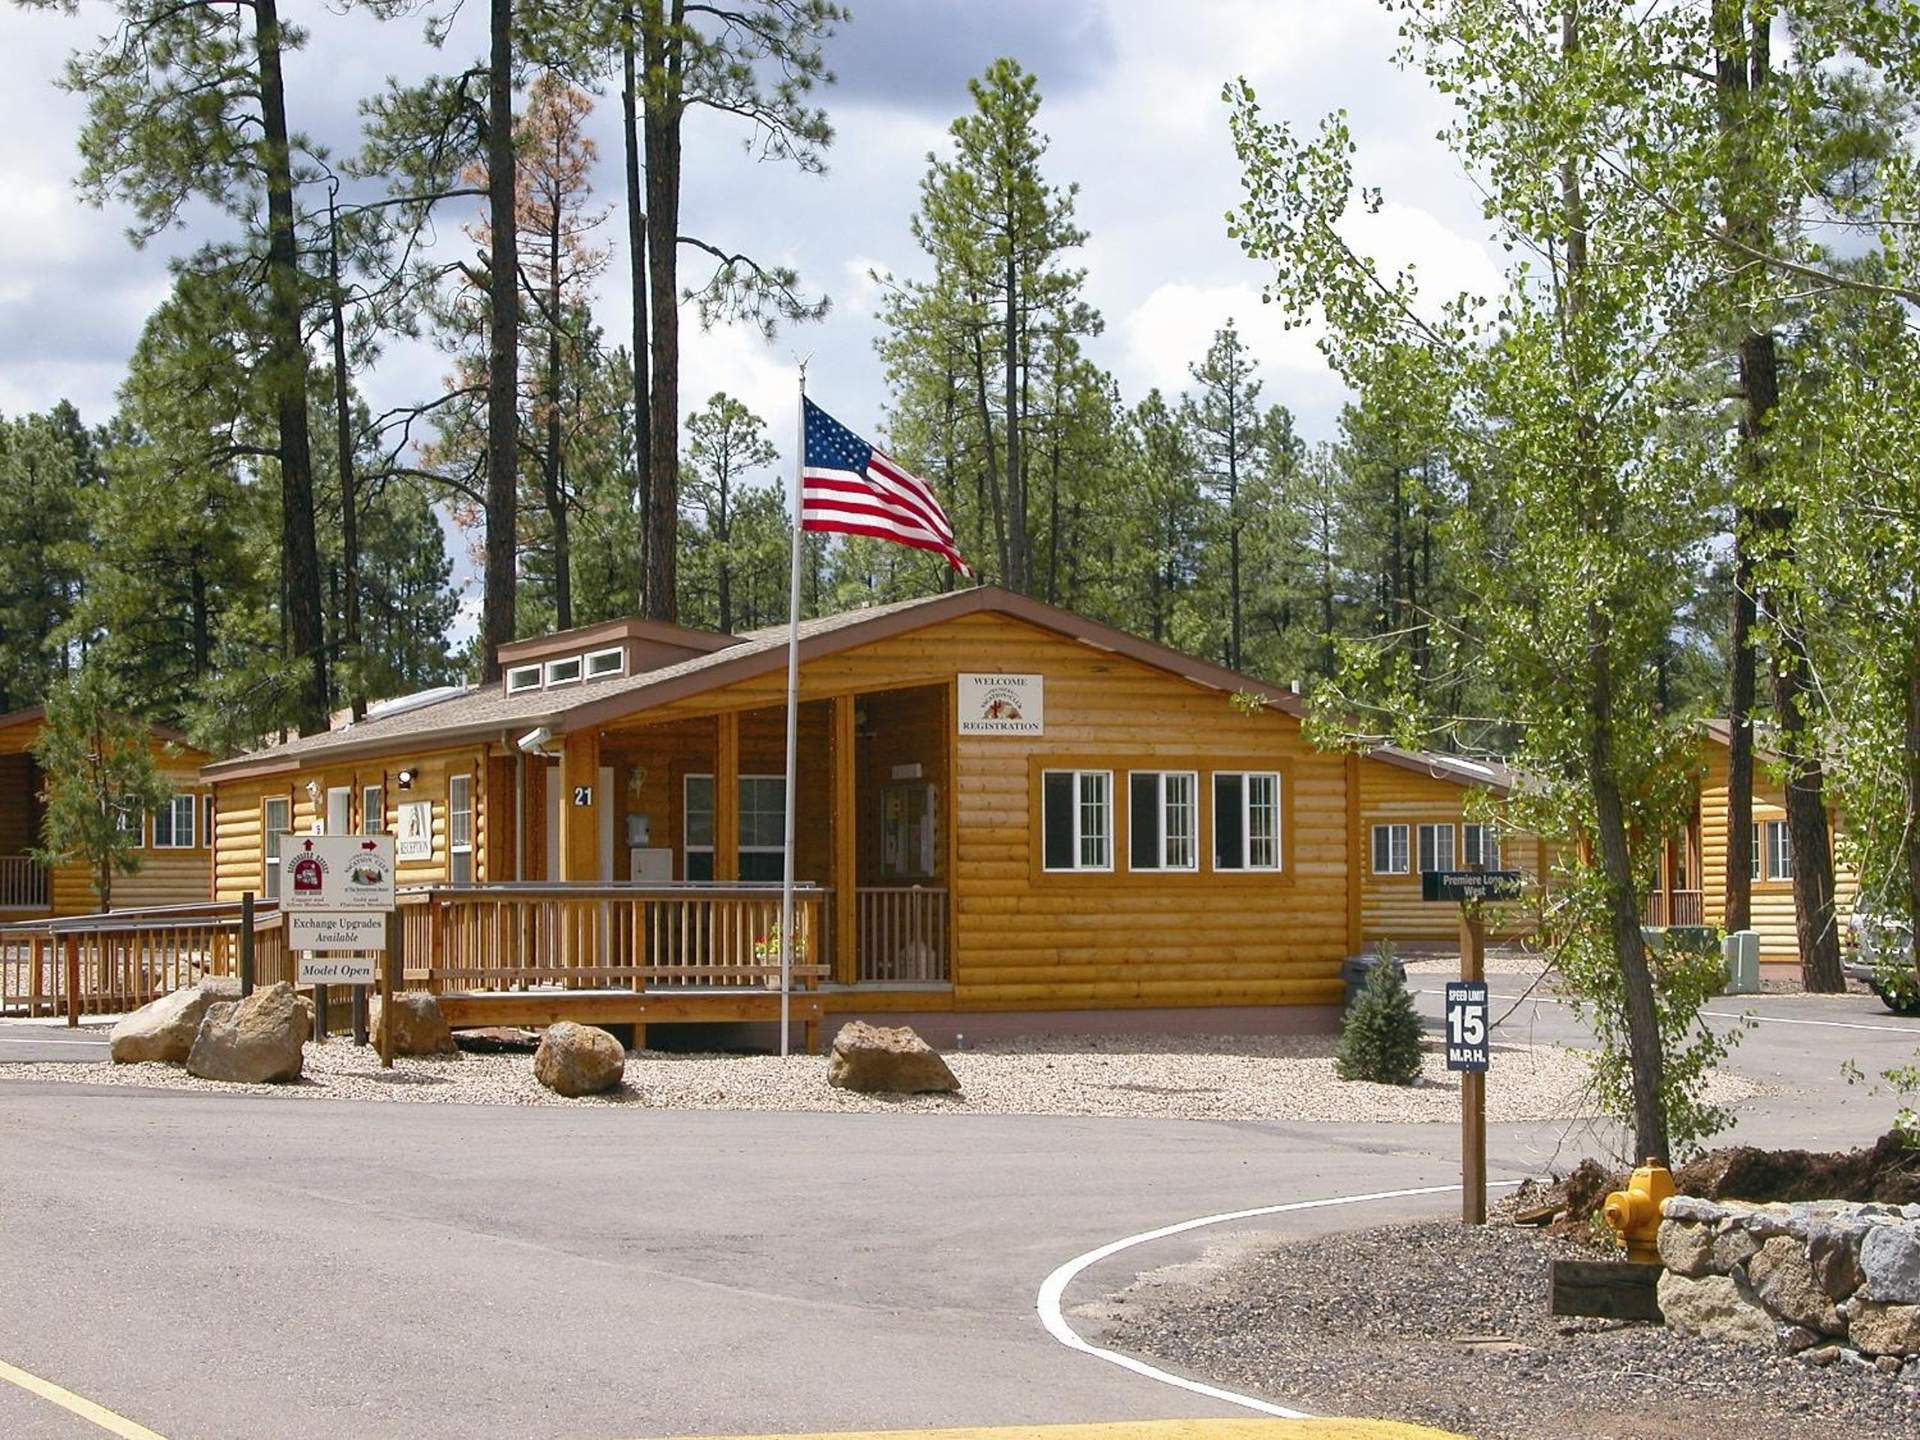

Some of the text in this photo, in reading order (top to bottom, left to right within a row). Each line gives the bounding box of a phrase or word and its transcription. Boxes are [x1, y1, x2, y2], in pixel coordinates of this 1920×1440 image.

[974, 677, 1027, 686] WELCOME
[963, 722, 1039, 731] REGISTRATION
[575, 787, 592, 806] 21
[400, 841, 428, 854] RECEPTION
[1443, 874, 1482, 886] Premiere
[1464, 886, 1486, 896] West
[293, 918, 382, 930] Exchange Upgrades
[315, 932, 358, 943] Available
[303, 965, 370, 978] Model Open
[1448, 989, 1486, 1002] SPEED LIMIT
[1448, 1005, 1484, 1045] 15
